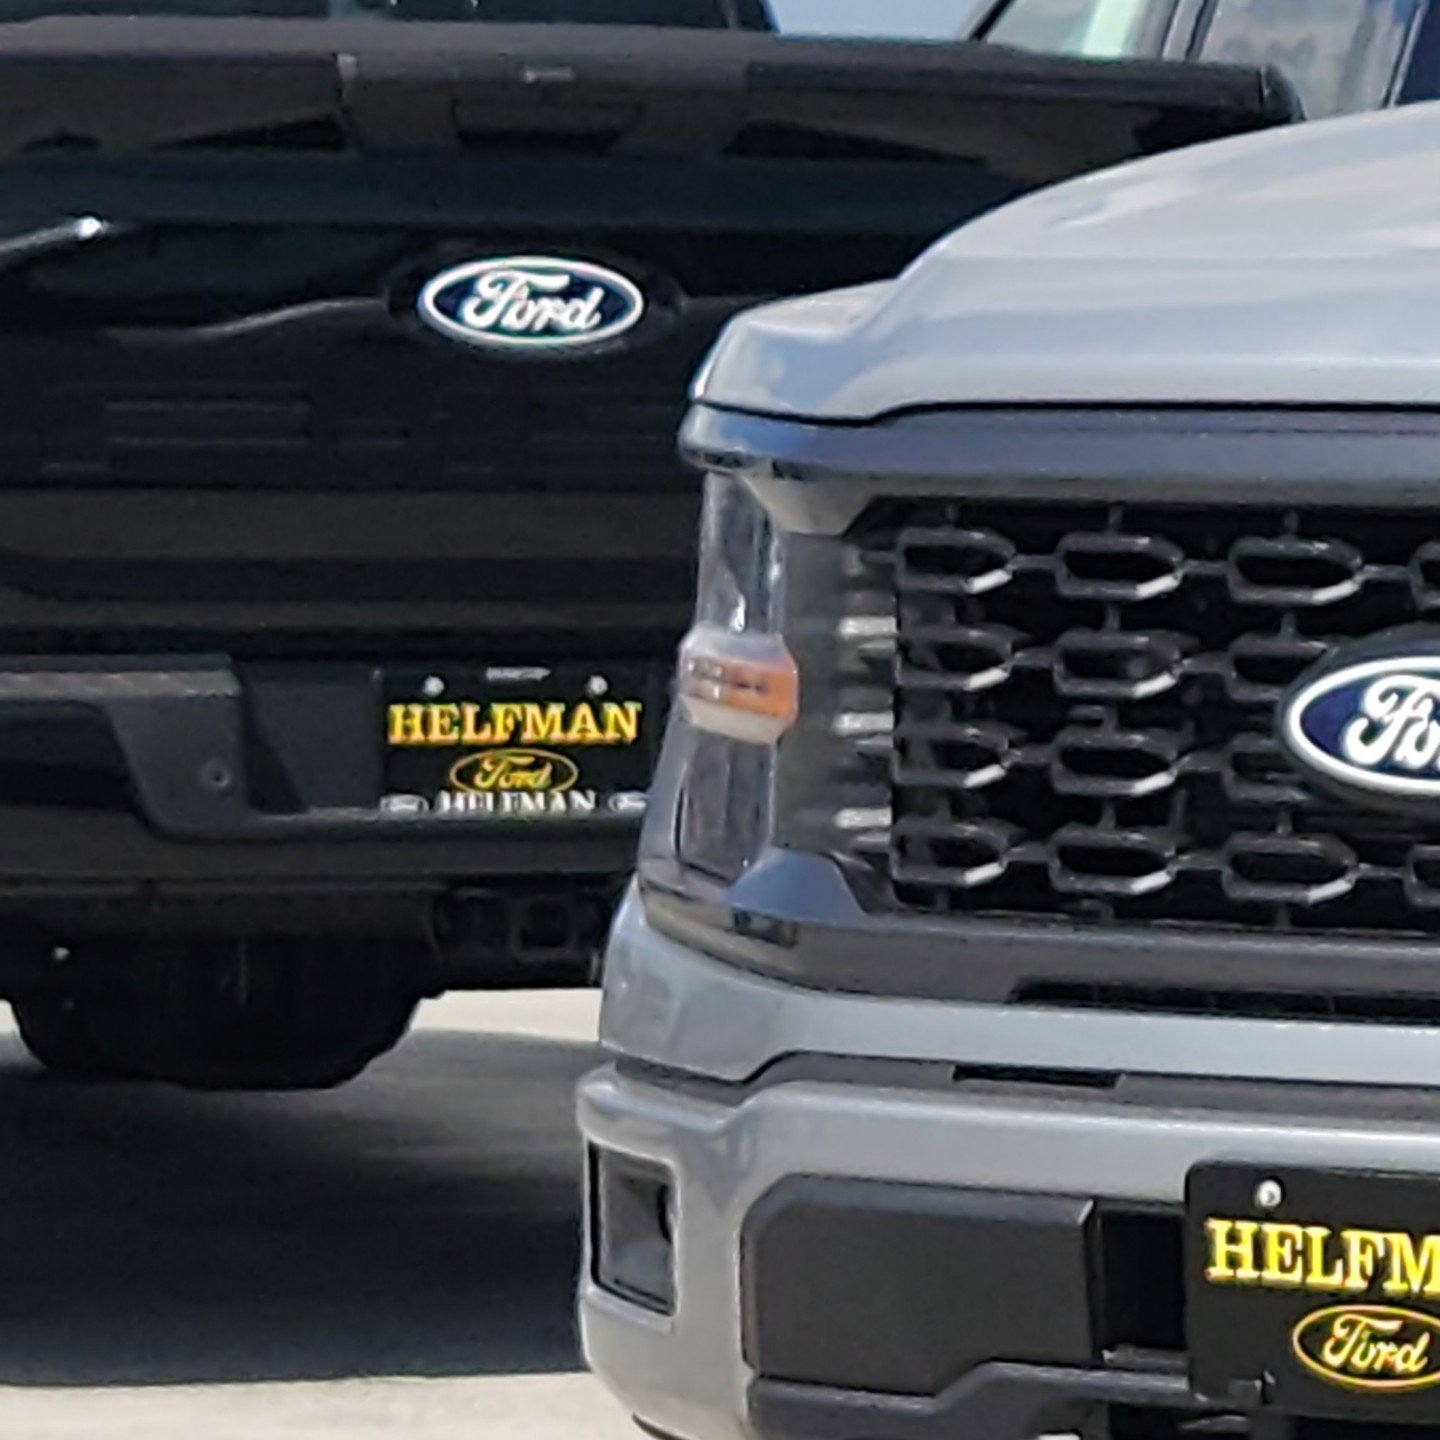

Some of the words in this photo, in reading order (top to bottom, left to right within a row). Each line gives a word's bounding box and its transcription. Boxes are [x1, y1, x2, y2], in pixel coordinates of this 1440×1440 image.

[462, 269, 605, 332] Ford
[387, 702, 642, 745] HELFMAN
[473, 753, 553, 790] Ford
[1322, 1312, 1432, 1373] Ford
